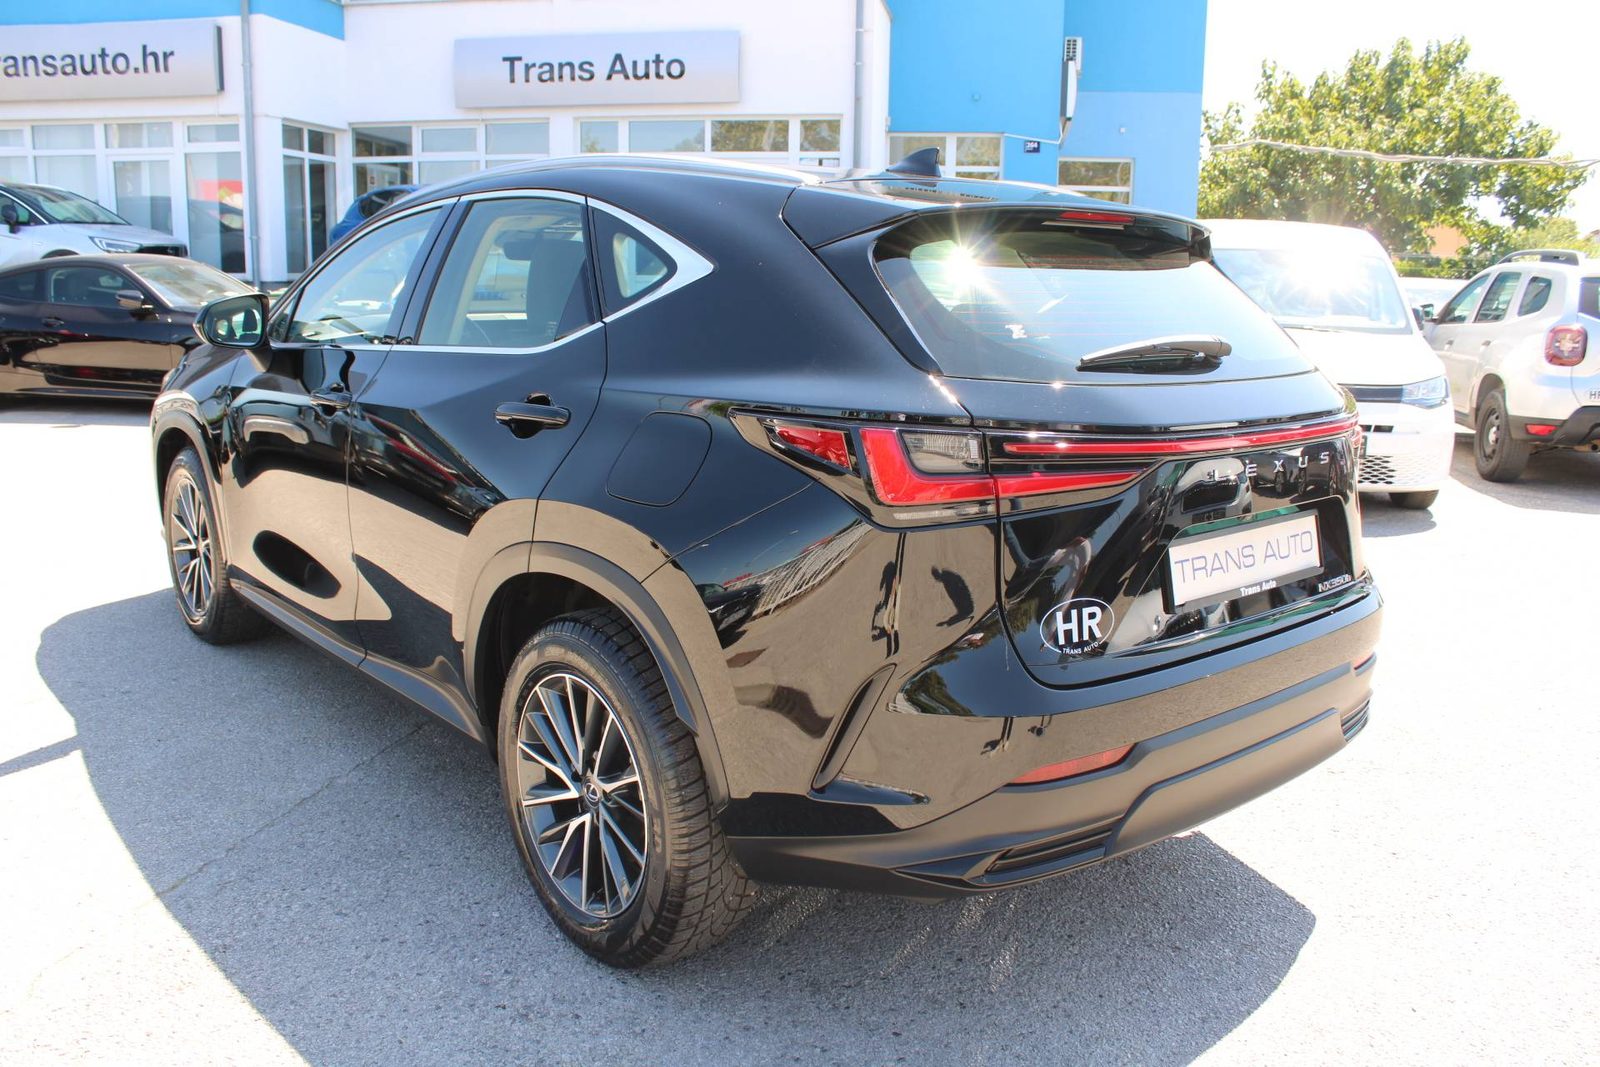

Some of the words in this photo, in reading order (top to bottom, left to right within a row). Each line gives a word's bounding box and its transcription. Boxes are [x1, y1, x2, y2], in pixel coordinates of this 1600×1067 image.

[0, 44, 175, 78] ansauto.hr
[502, 55, 595, 84] Trans
[606, 52, 686, 81] Auto
[1212, 451, 1330, 482] LEXUS
[1174, 544, 1256, 583] TRANS
[1263, 530, 1313, 564] AUTO
[1240, 584, 1261, 597] Trans
[1261, 579, 1277, 592] Auto
[1055, 606, 1103, 646] HR
[1062, 647, 1082, 655] TRANS
[1083, 641, 1099, 653] AUTO
